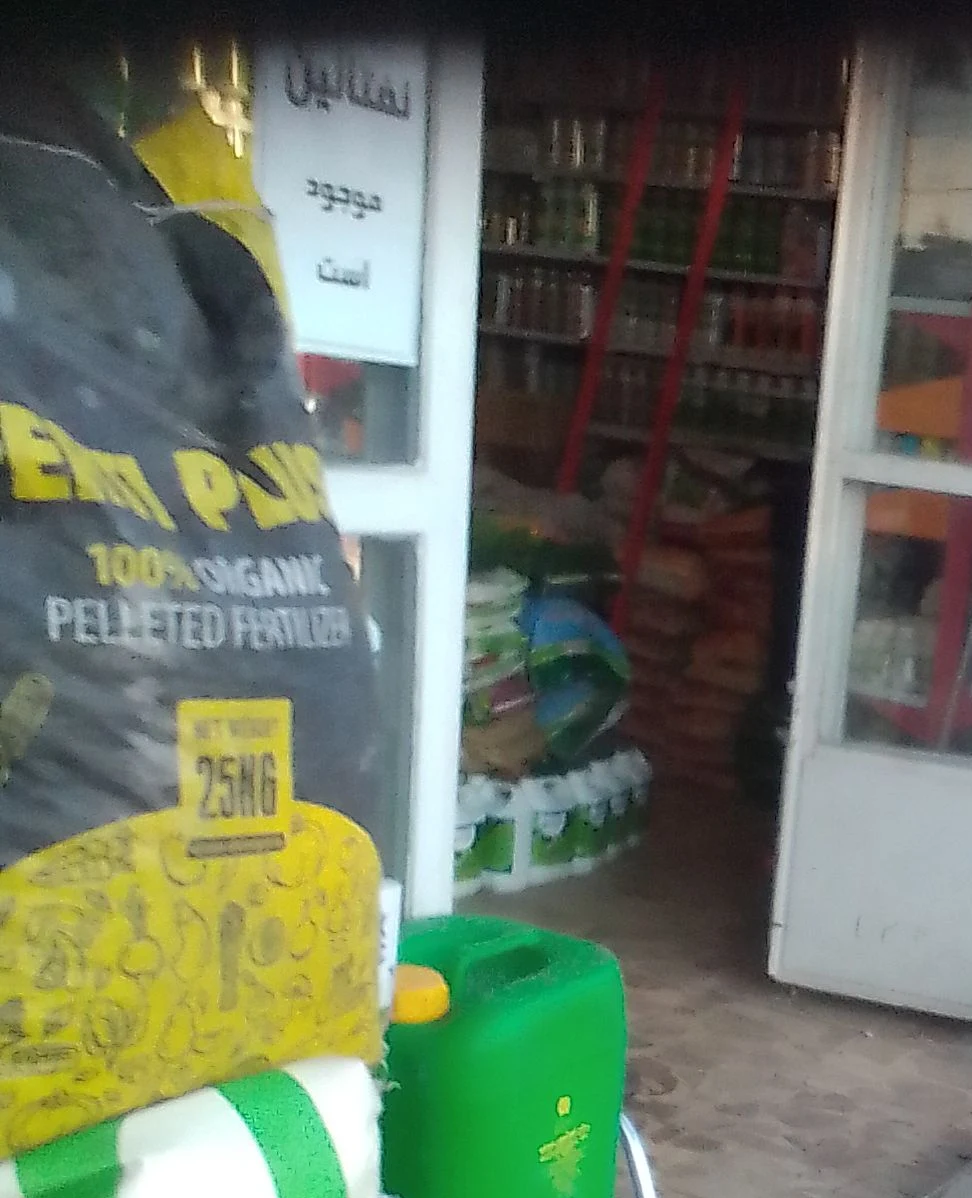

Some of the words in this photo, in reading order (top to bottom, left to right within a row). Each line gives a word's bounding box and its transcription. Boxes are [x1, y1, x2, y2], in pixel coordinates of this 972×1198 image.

[306, 178, 383, 219] موجود
[316, 257, 371, 290] است
[46, 596, 225, 650] PELLETED
